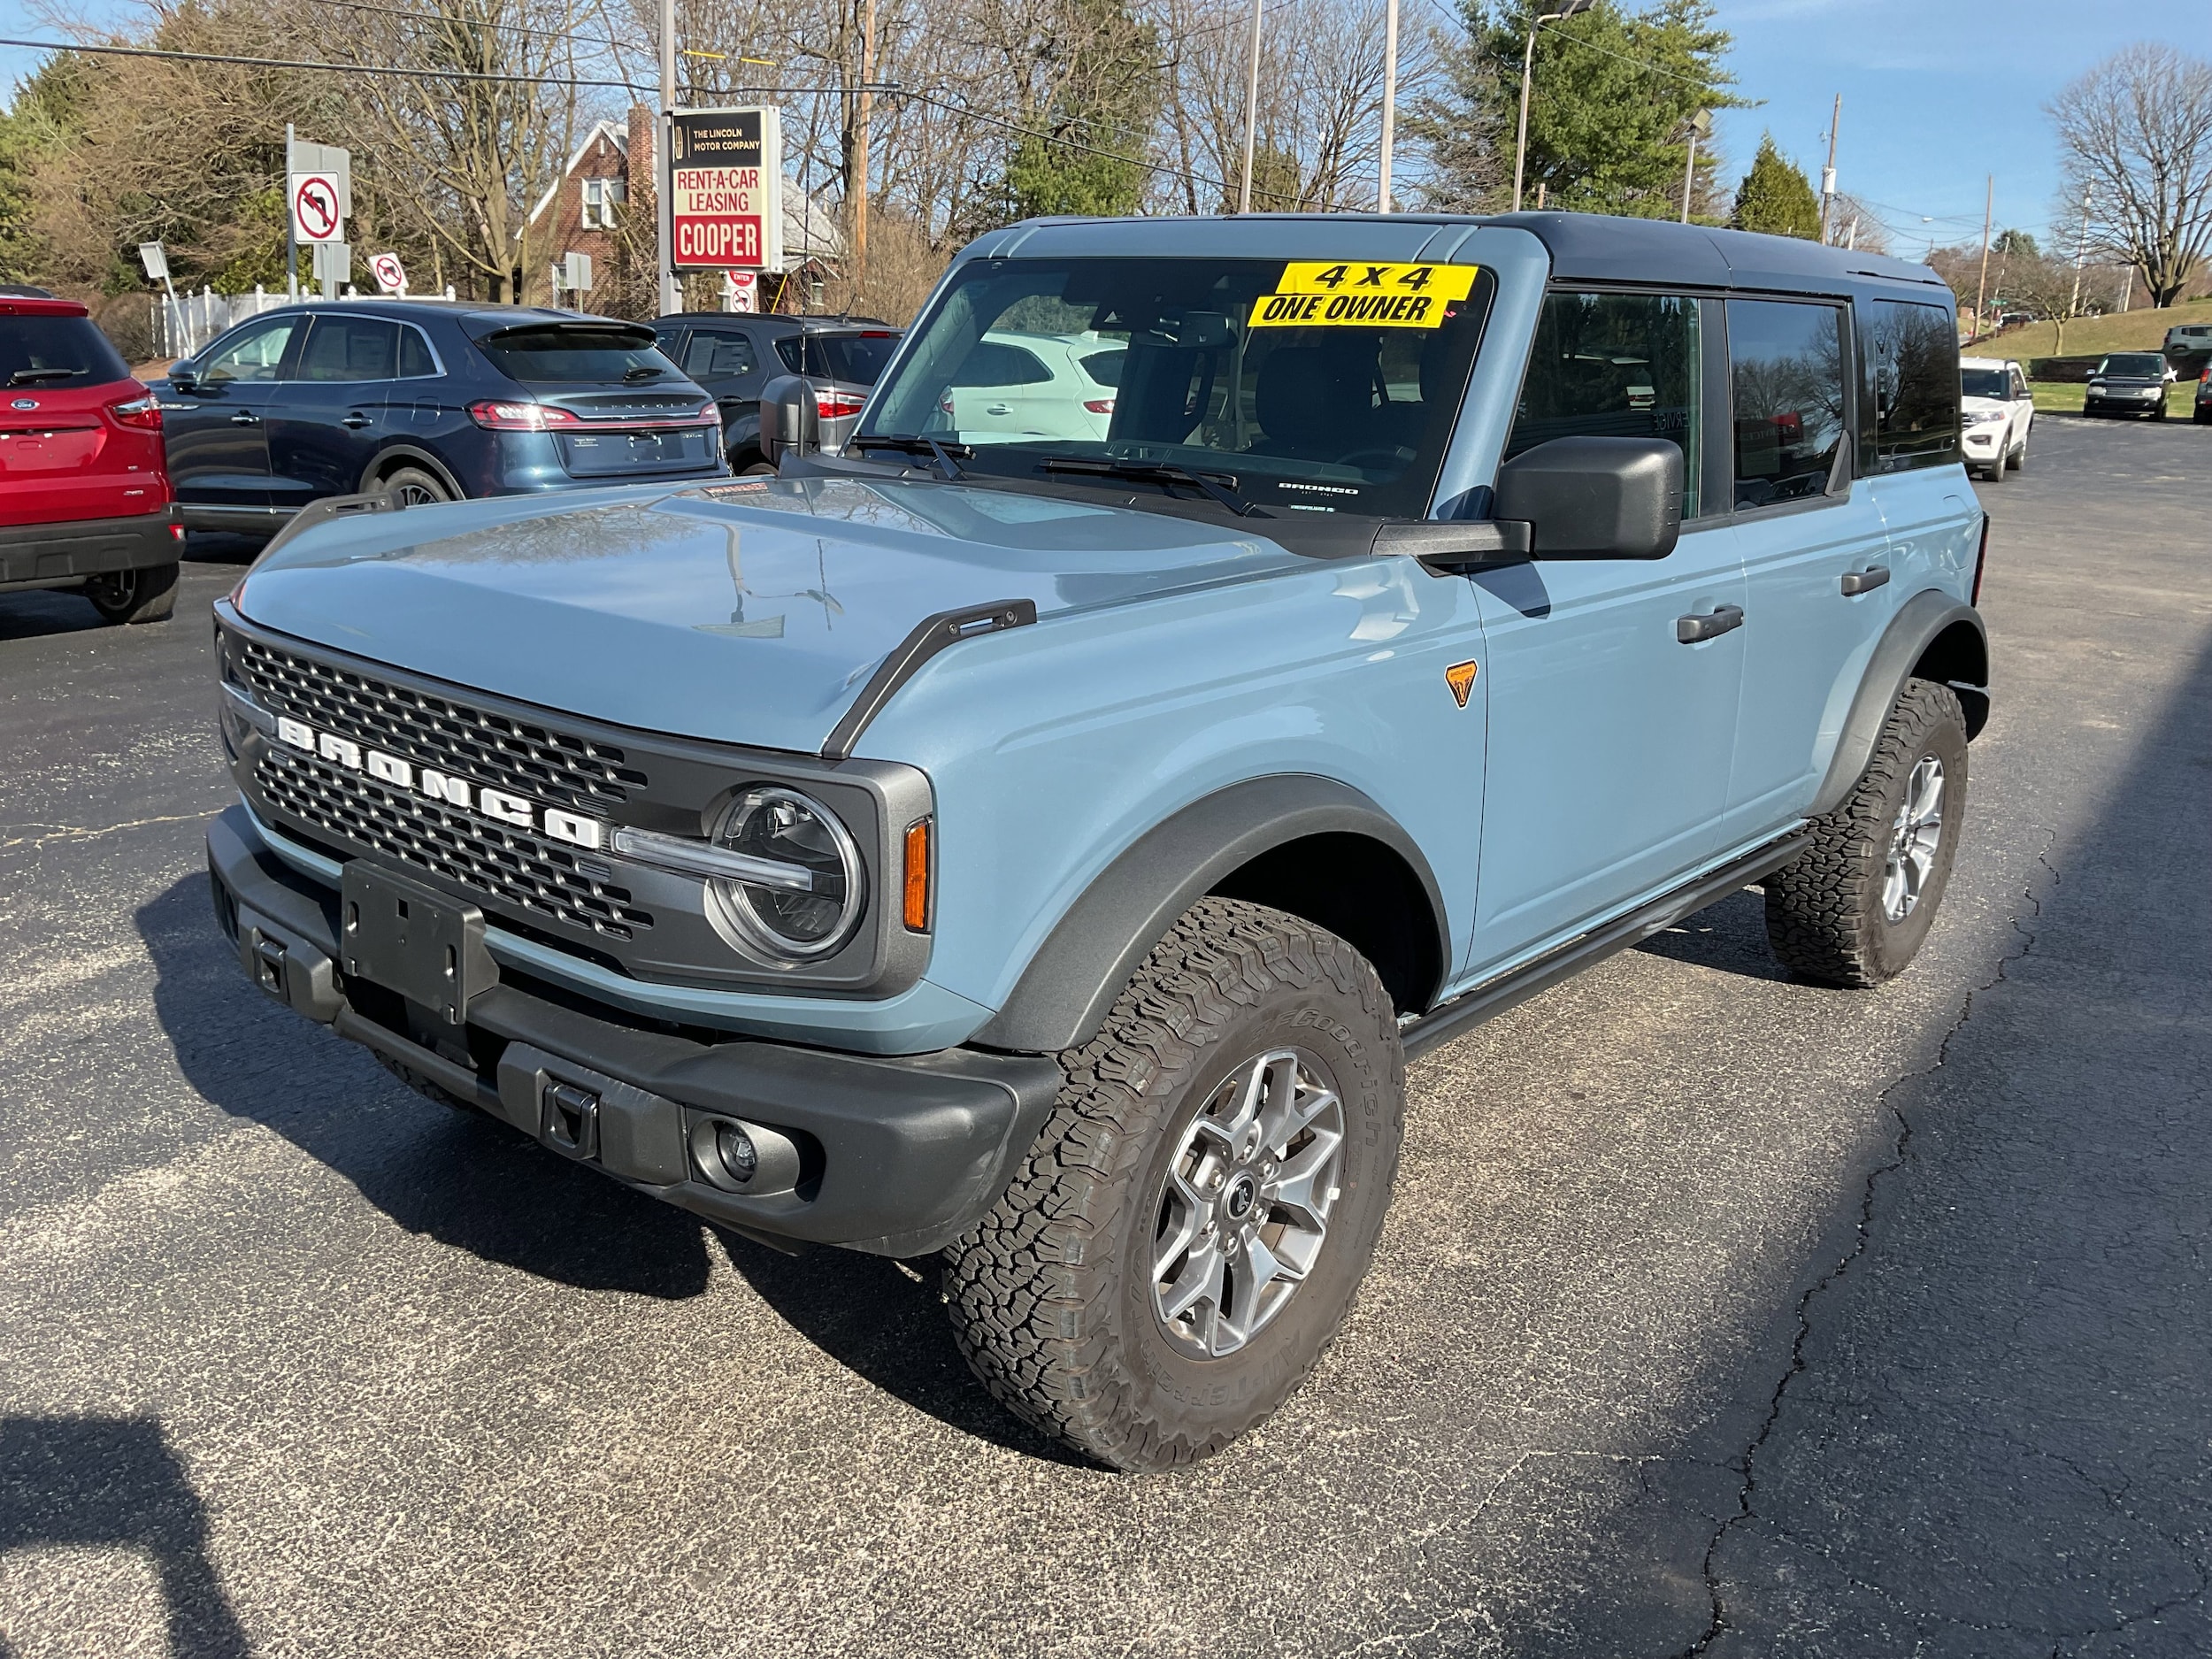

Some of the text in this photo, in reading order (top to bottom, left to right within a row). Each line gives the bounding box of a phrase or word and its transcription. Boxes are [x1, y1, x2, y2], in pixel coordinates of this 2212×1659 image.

[693, 128, 742, 139] THE LINCOLN
[694, 140, 760, 151] MOTOR COMPANY
[678, 169, 758, 190] RENT-A-CAR
[688, 191, 749, 212] LEASING
[680, 223, 757, 257] COOPER
[1262, 296, 1433, 322] ONE OWNER
[278, 715, 600, 849] BRONCO
